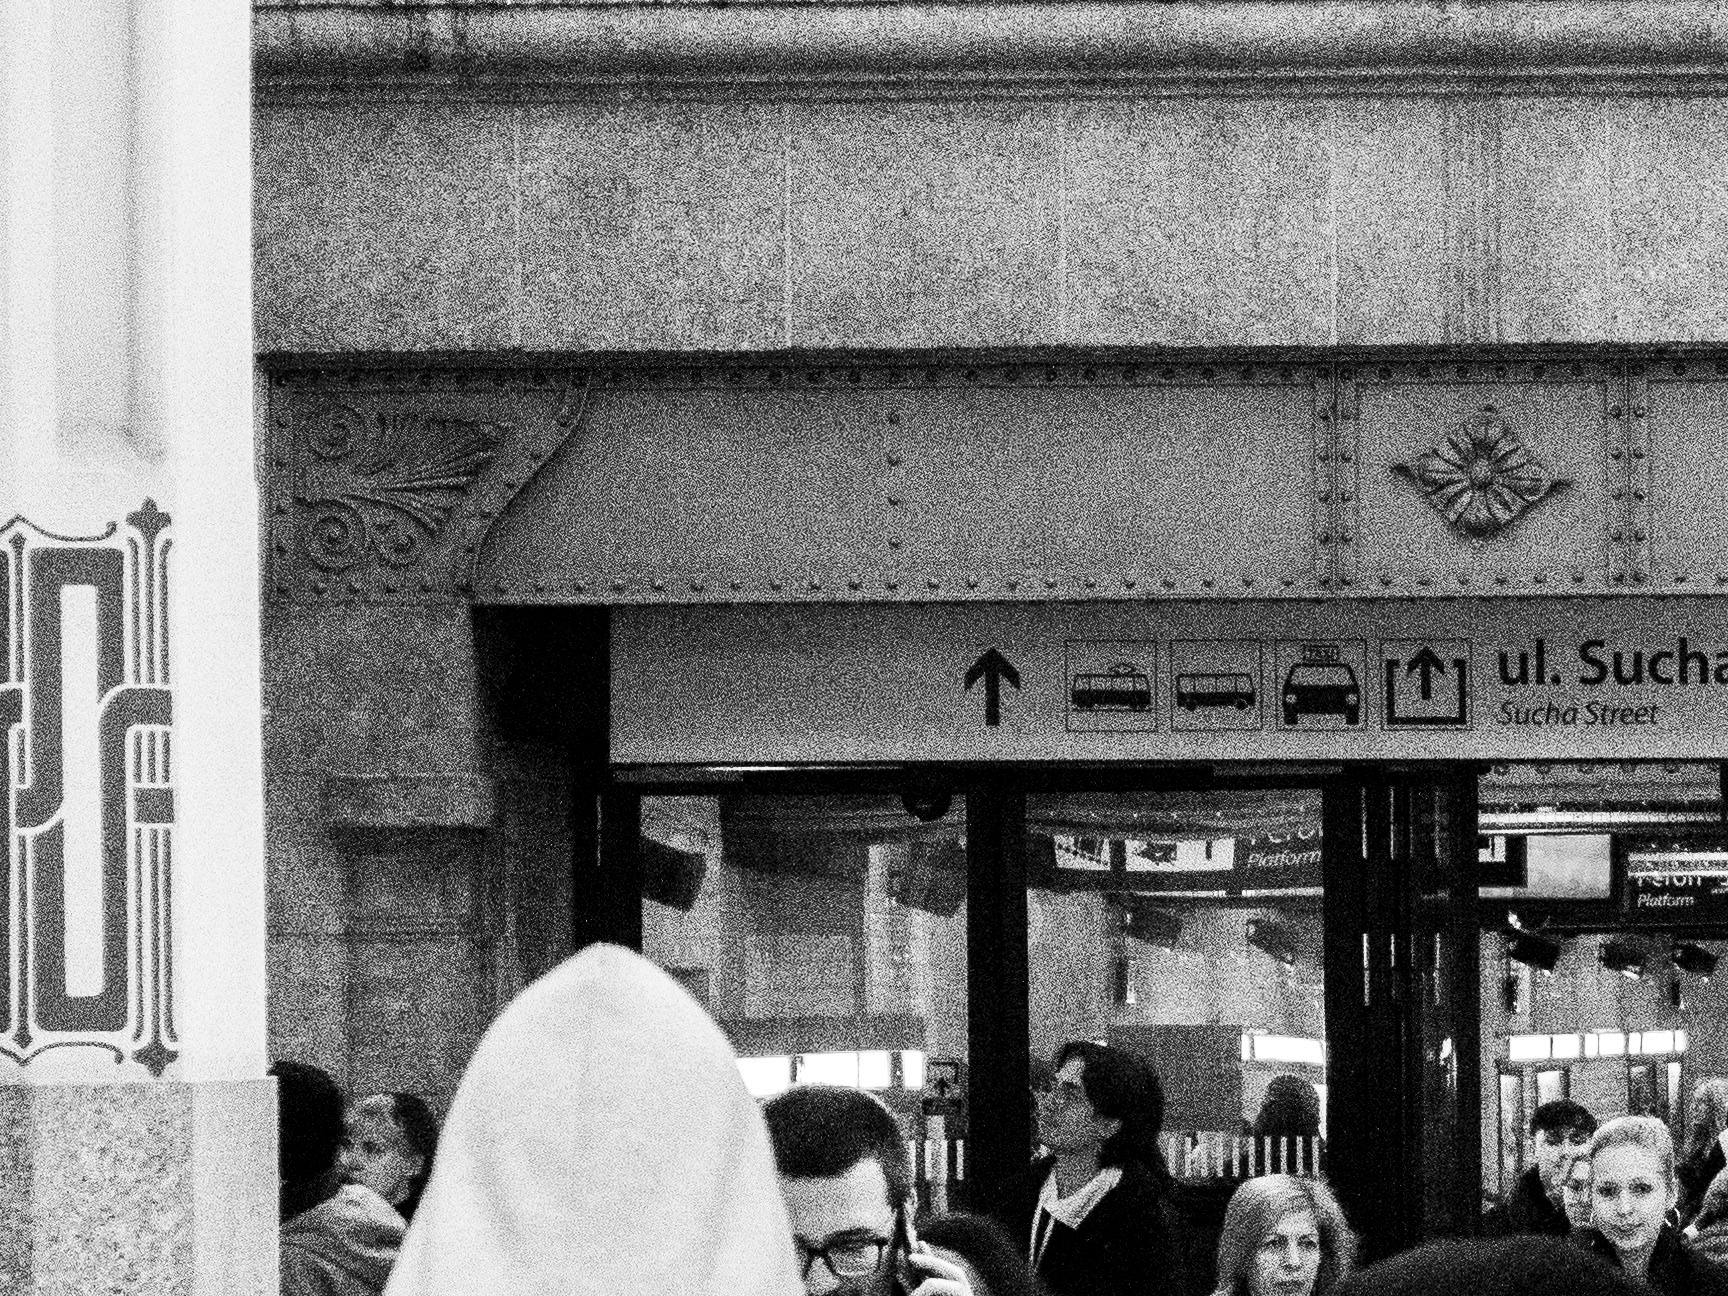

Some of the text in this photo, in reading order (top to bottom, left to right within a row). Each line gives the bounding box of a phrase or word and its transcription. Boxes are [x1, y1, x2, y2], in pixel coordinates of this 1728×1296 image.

[1499, 637, 1561, 686] ul.
[1499, 702, 1659, 726] Sucha Street
